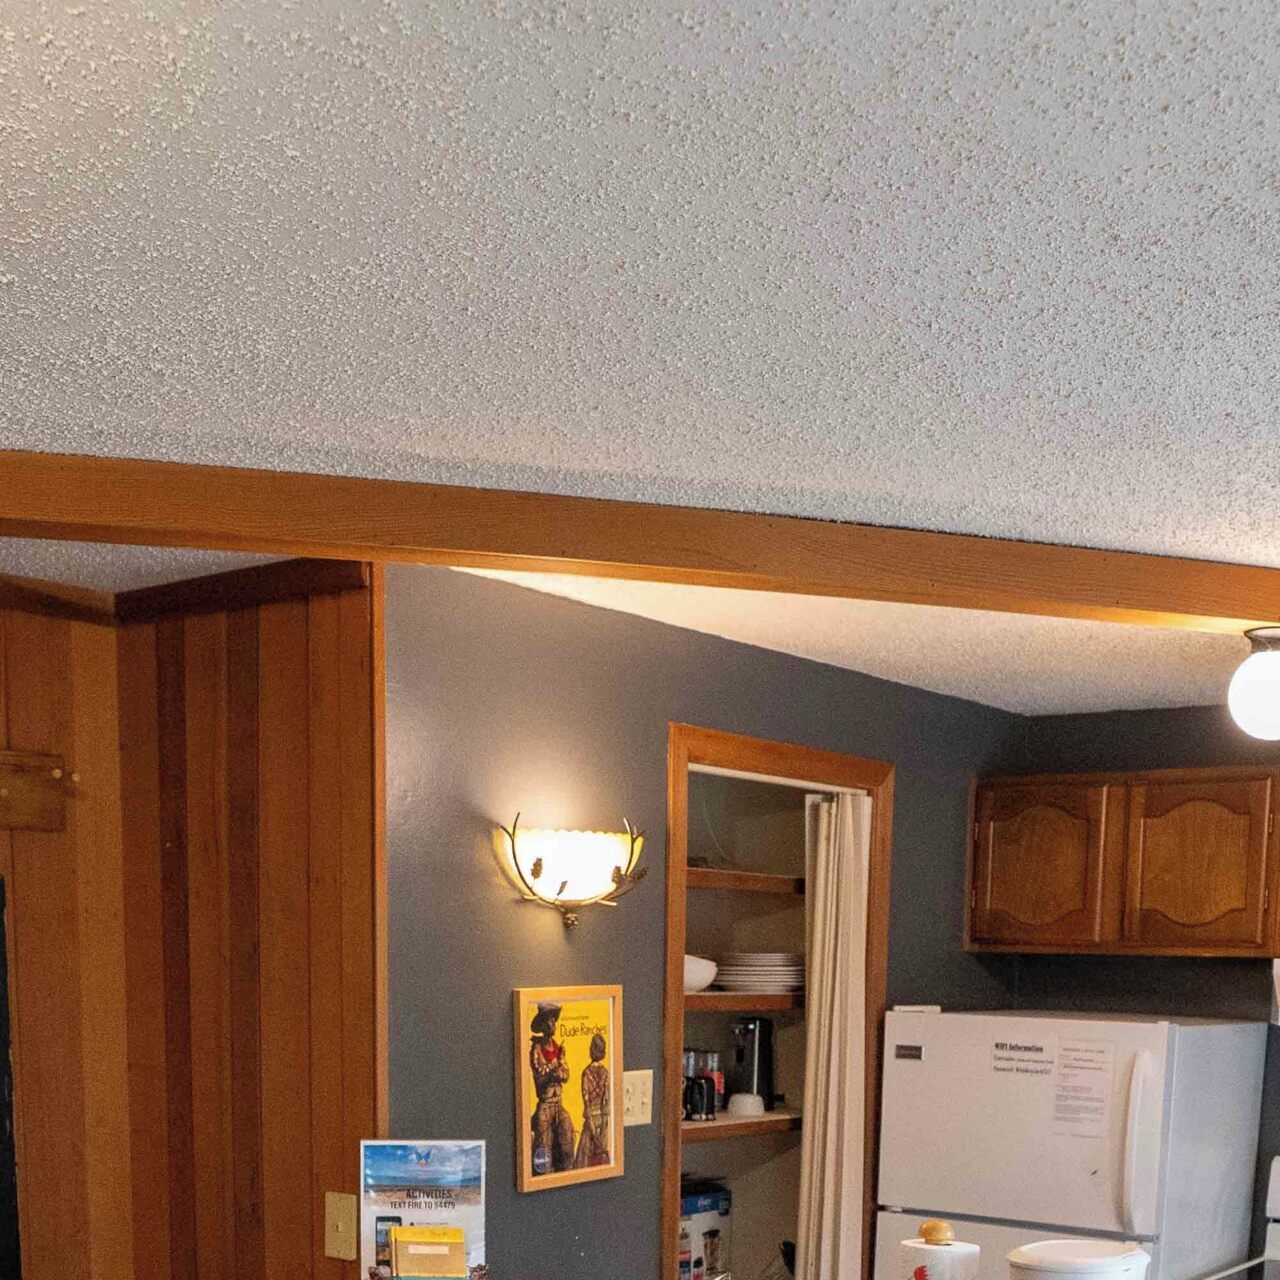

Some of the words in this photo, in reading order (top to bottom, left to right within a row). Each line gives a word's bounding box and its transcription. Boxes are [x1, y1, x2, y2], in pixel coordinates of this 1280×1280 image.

[560, 1023, 580, 1037] Dude
[406, 1189, 453, 1199] ACTIVITIES
[390, 1201, 406, 1209] TEXT
[407, 1201, 422, 1209] FIRE
